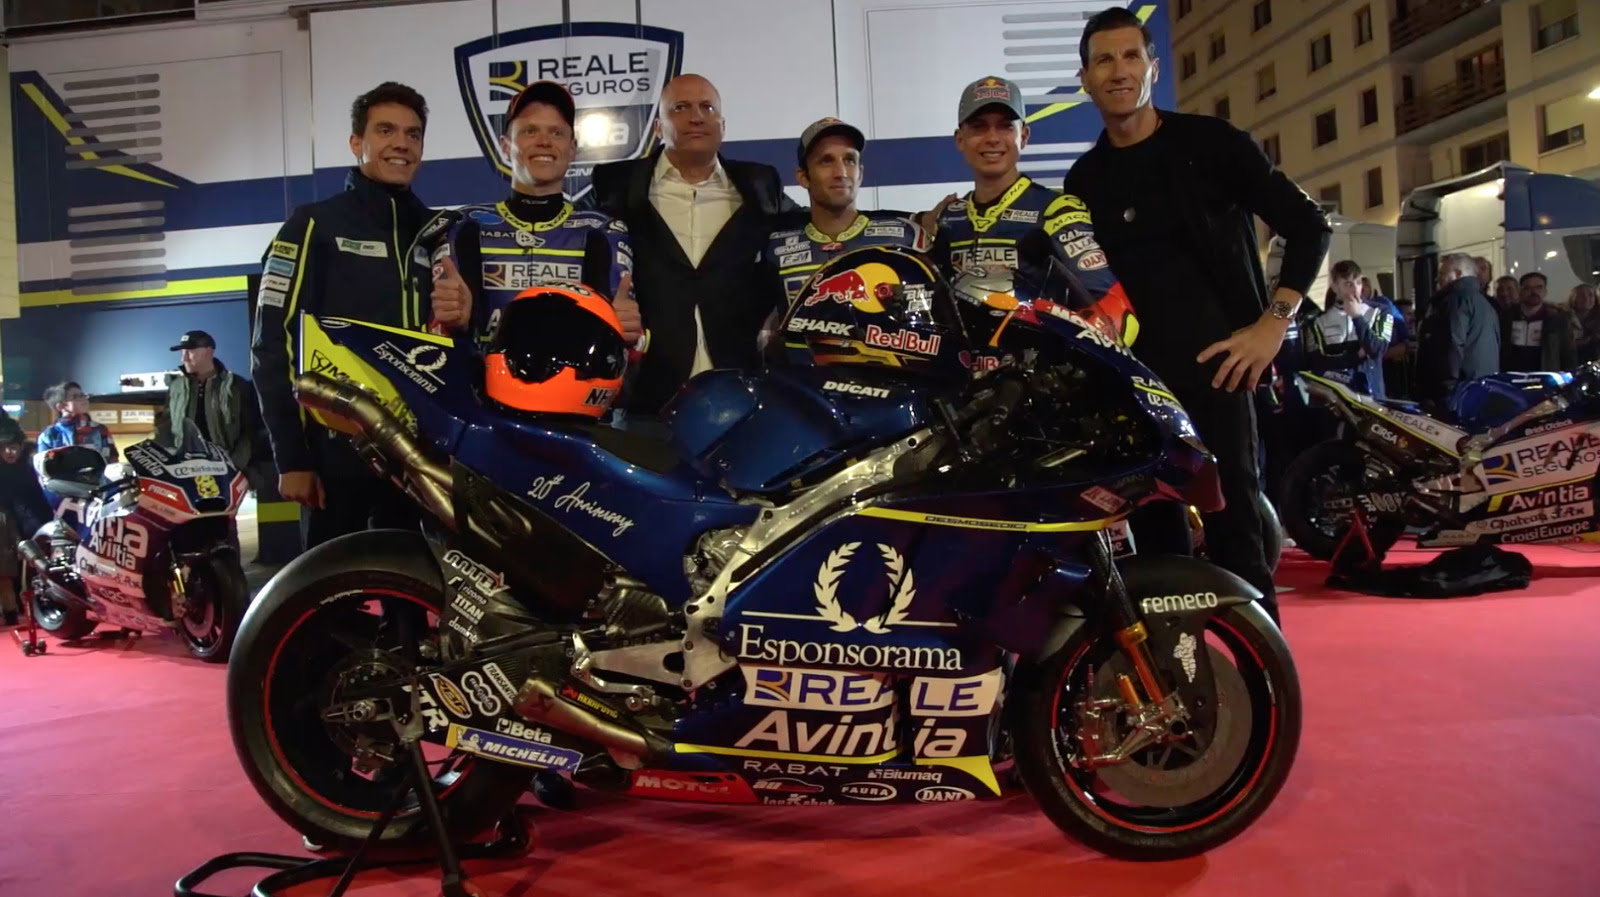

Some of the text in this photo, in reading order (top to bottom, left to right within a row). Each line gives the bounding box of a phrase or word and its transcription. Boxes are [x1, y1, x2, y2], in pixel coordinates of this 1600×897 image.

[537, 51, 650, 80] REALE
[564, 76, 651, 97] GUROS
[1052, 213, 1090, 229] MACN
[965, 248, 1016, 262] REALE
[511, 263, 580, 281] REALE
[788, 316, 855, 337] SHARK
[865, 324, 941, 355] Red Bull
[372, 341, 439, 395] Esponsorama
[822, 380, 891, 399] DUCATI
[1393, 411, 1435, 434] REALE
[1507, 484, 1589, 512] Avintia
[454, 593, 485, 621] TITAN
[737, 622, 963, 672] Esponsorama
[510, 722, 553, 744] Beta
[483, 741, 570, 767] MICHELIN
[743, 760, 849, 778] RABAT
[841, 785, 889, 797] FAURA
[922, 789, 963, 801] DANI
